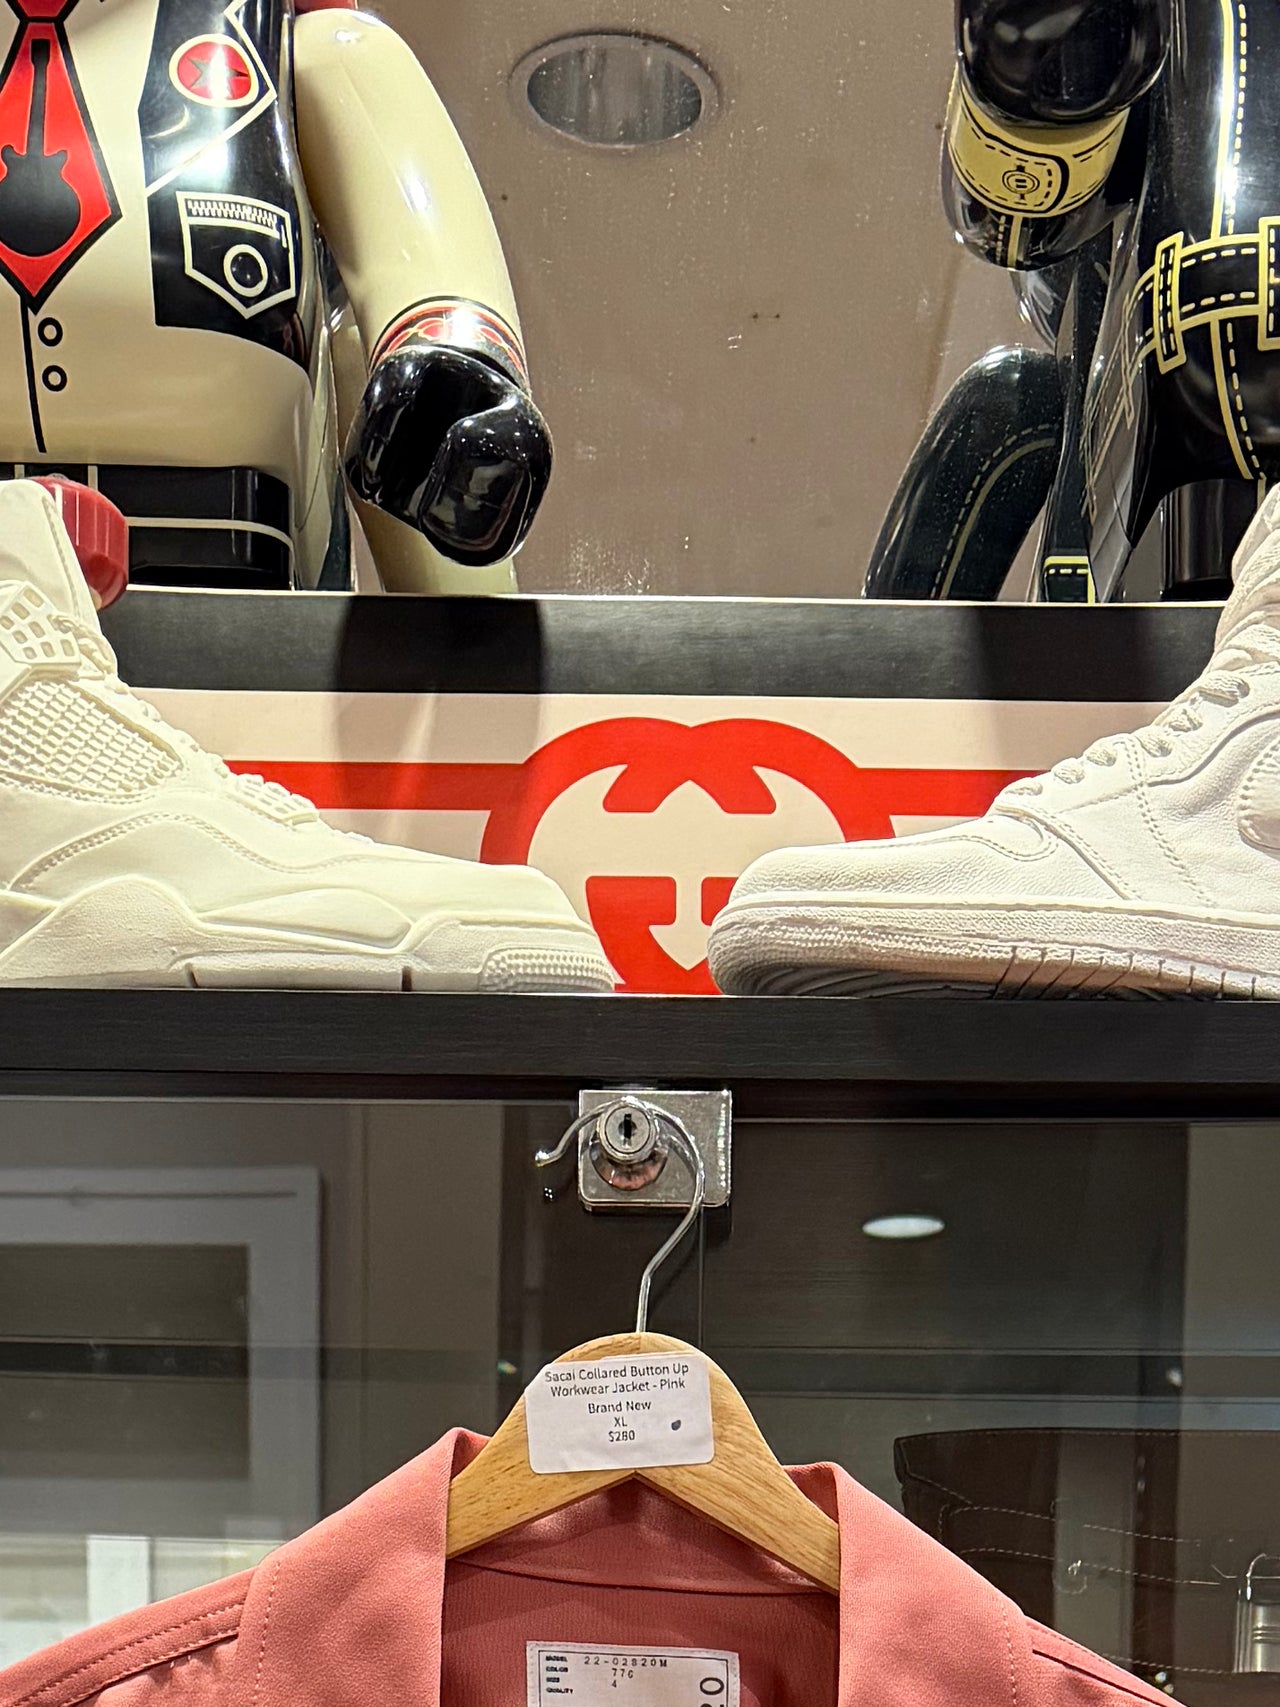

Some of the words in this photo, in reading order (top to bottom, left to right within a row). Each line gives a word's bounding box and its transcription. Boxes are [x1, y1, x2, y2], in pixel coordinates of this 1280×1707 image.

[545, 1370, 576, 1382] Sacai
[578, 1365, 627, 1381] Collared
[630, 1364, 670, 1377] Button
[672, 1362, 689, 1377] Up
[550, 1384, 610, 1397] Workwear
[612, 1381, 650, 1394] Jacket
[660, 1377, 686, 1390] Pink
[588, 1401, 623, 1414] Brand
[626, 1400, 652, 1412] New
[613, 1416, 628, 1428] XL
[608, 1430, 636, 1443] $280
